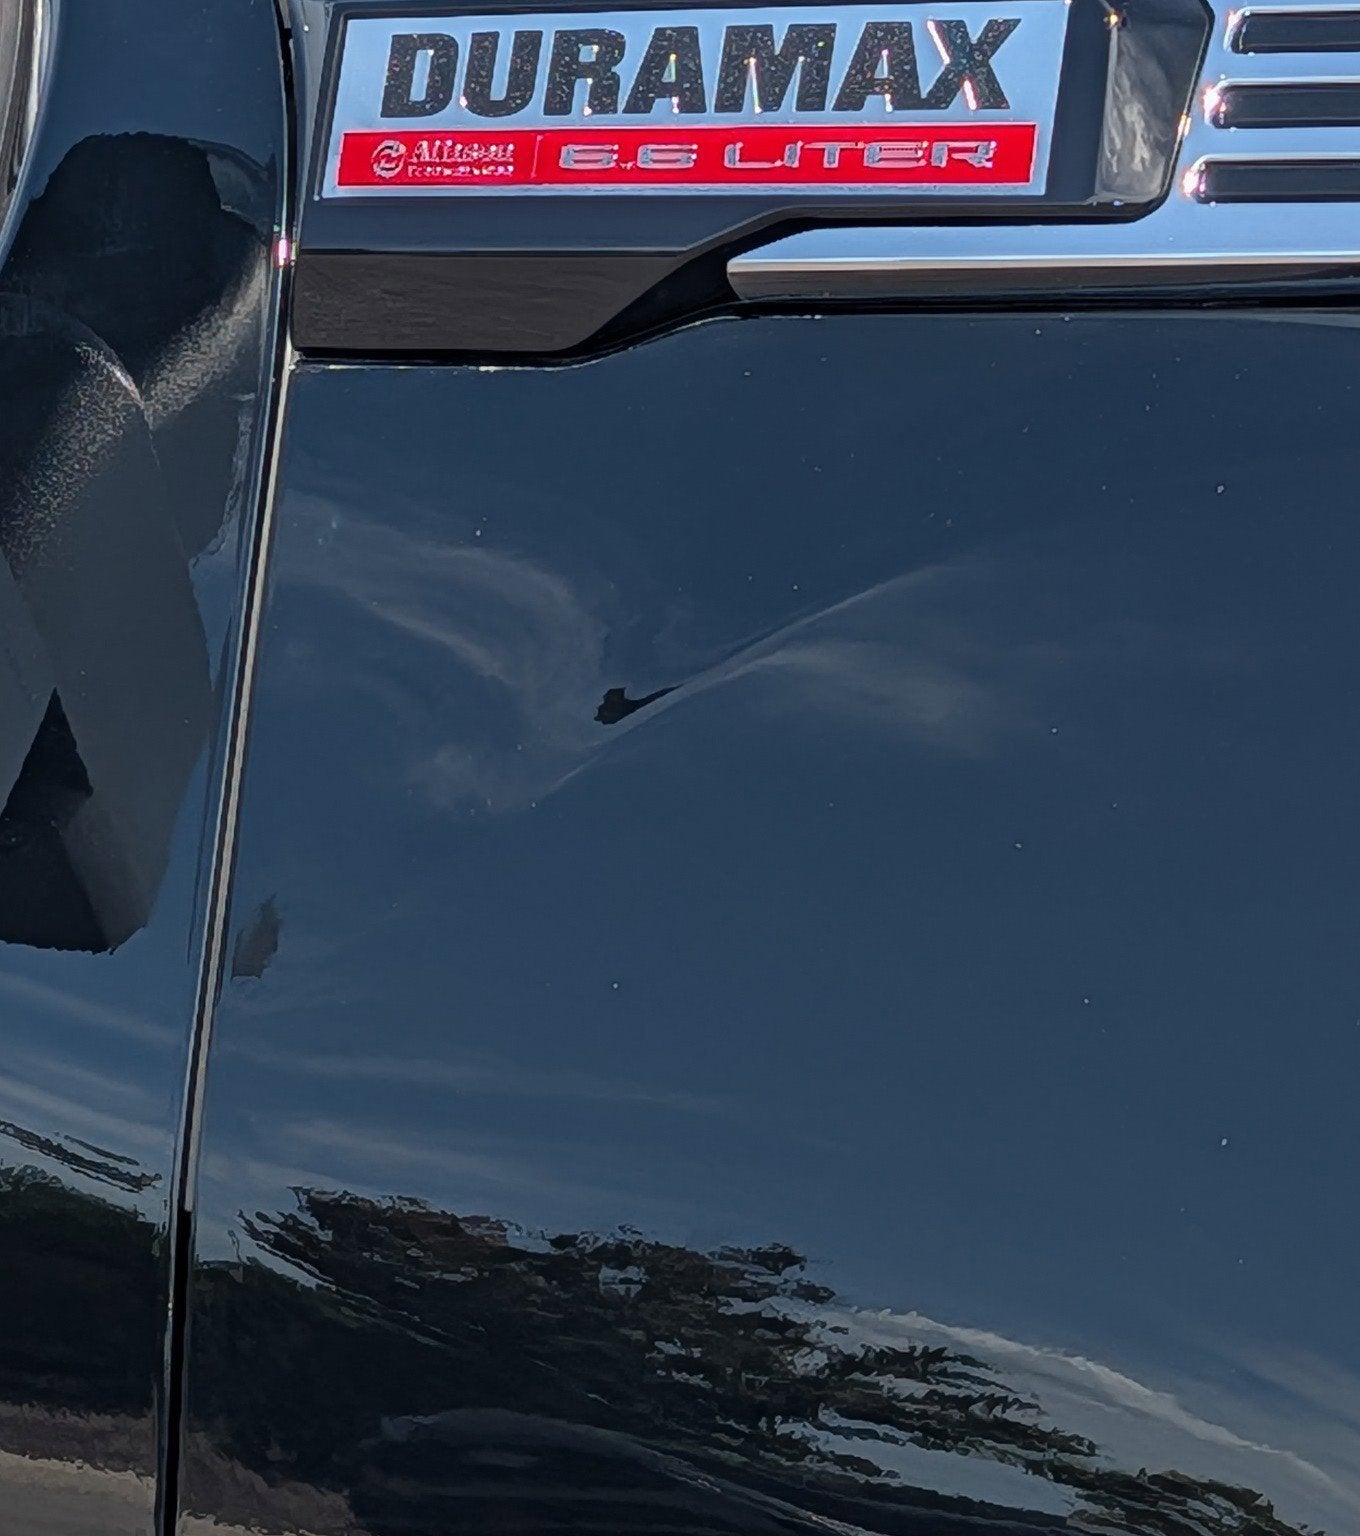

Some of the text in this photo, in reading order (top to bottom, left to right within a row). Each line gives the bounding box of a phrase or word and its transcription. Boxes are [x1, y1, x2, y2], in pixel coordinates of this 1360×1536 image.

[380, 18, 1022, 119] DURAMAX
[559, 140, 997, 169] 6.6 LITER
